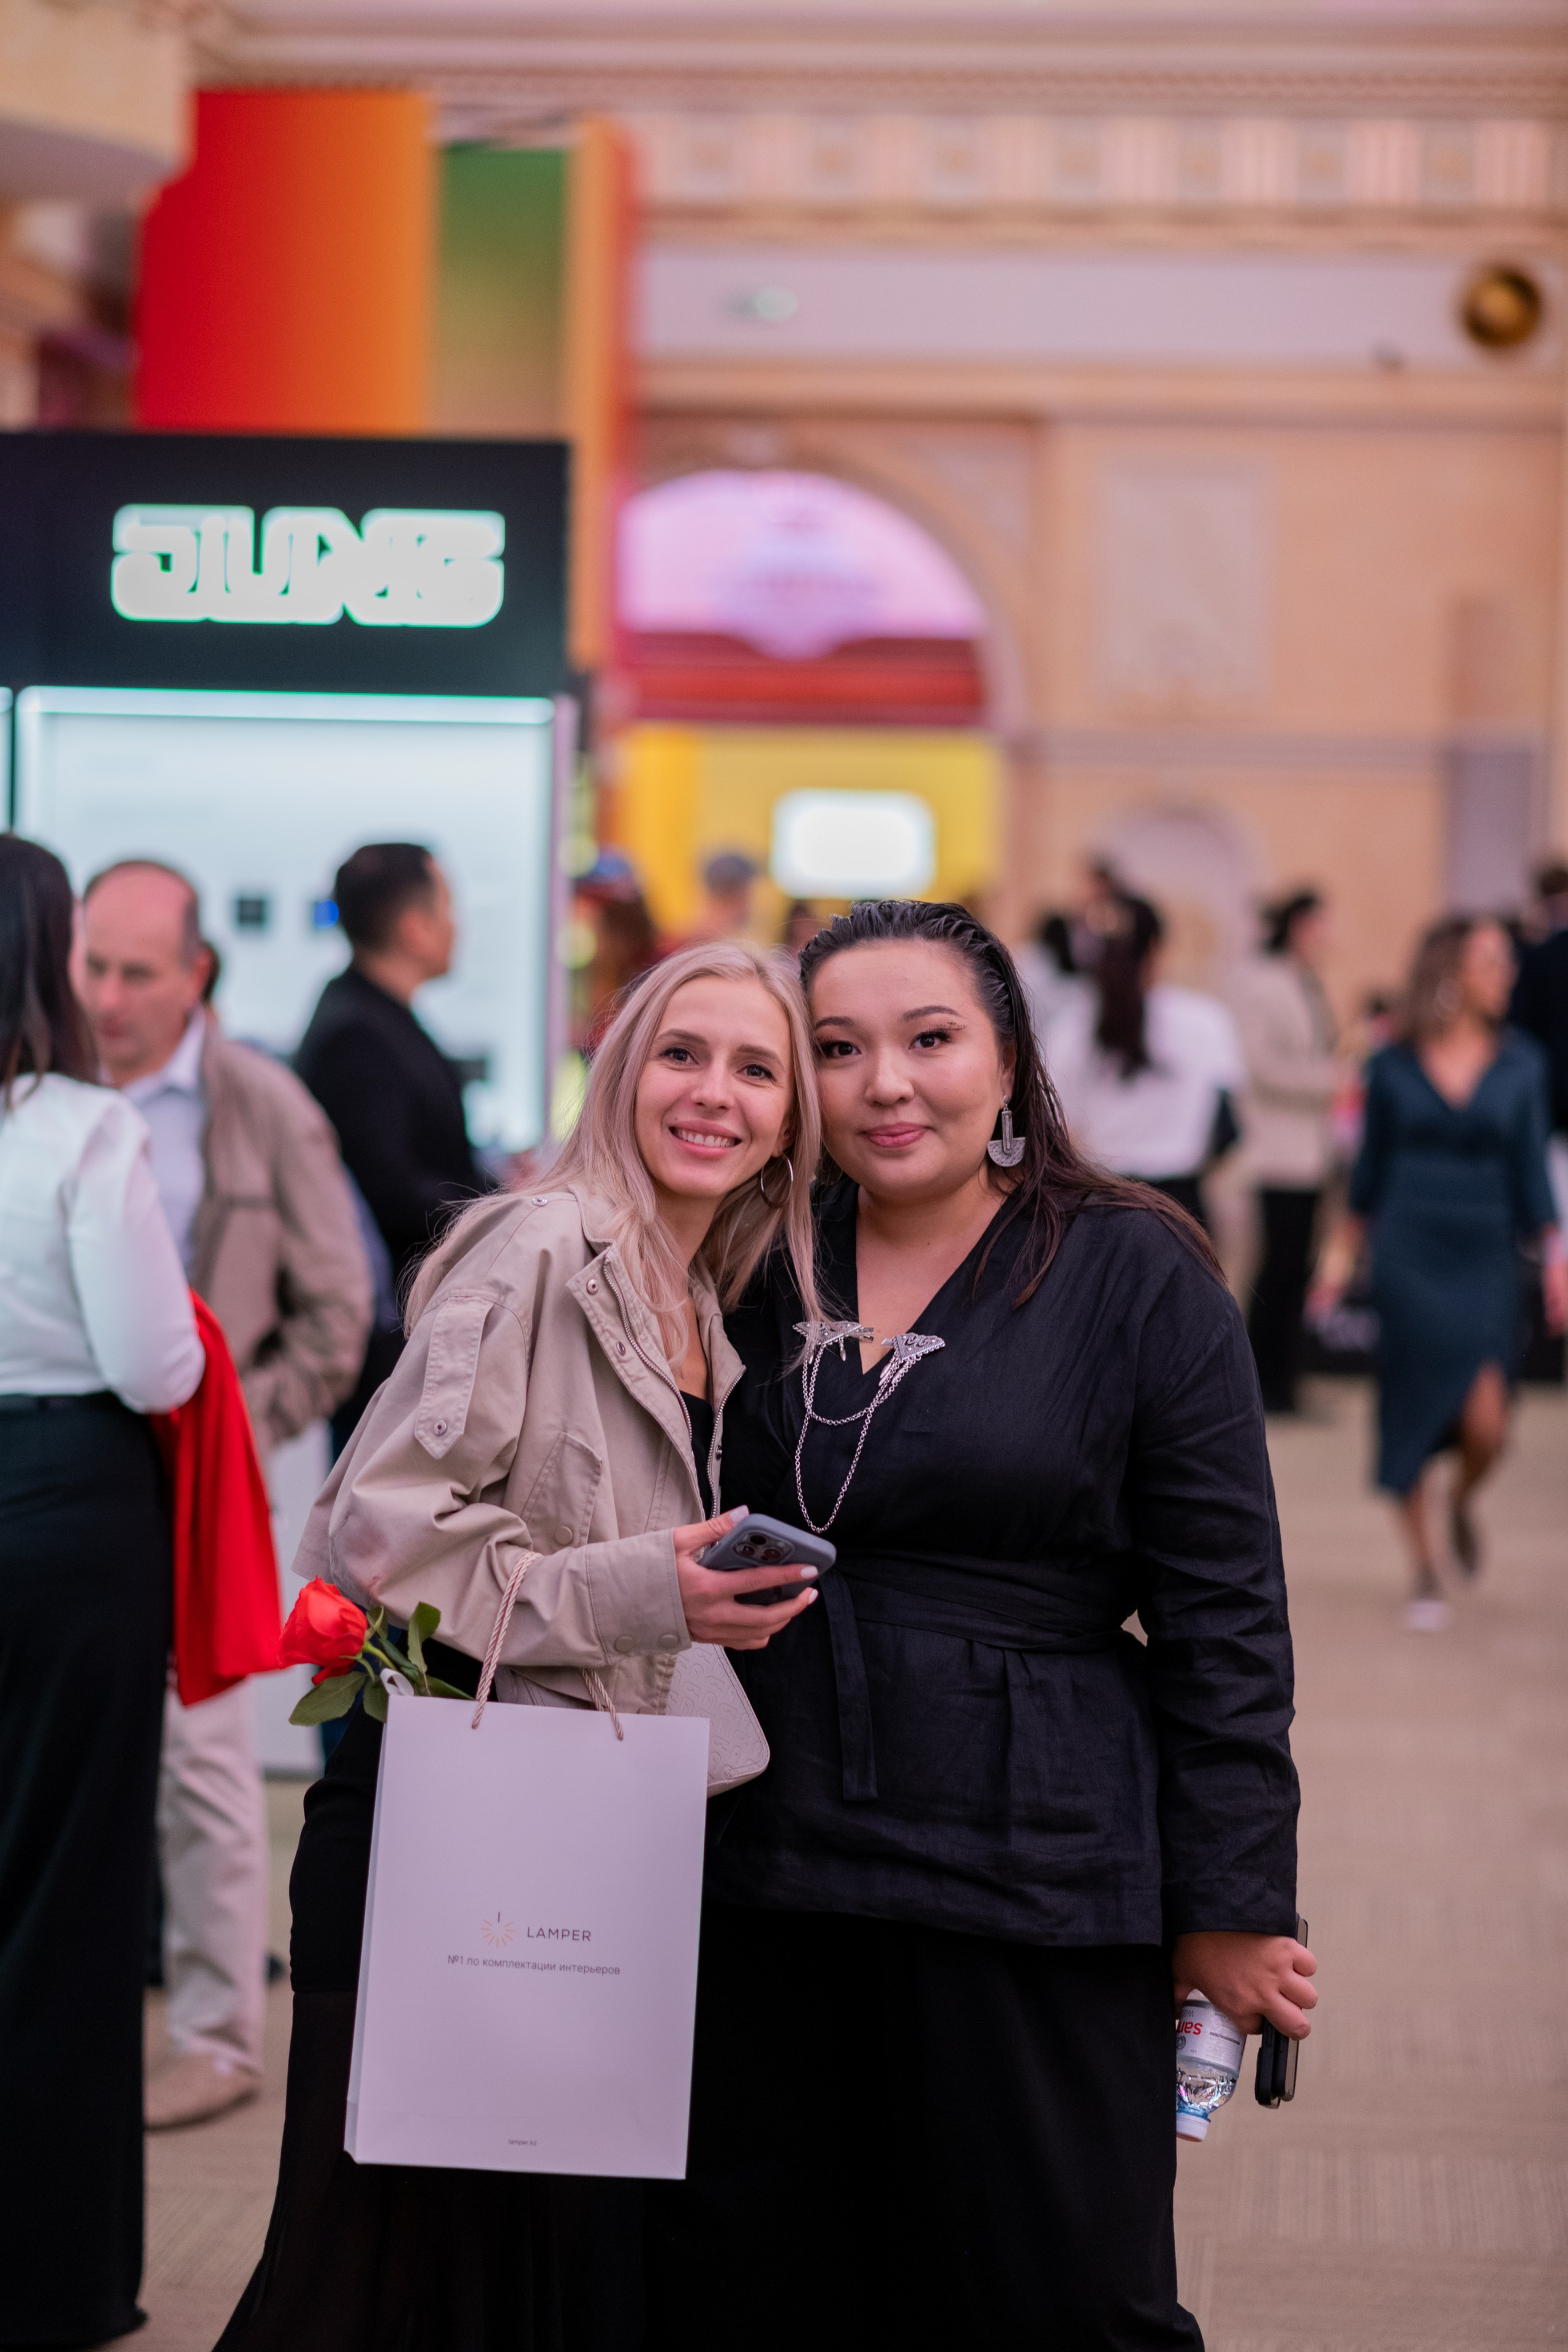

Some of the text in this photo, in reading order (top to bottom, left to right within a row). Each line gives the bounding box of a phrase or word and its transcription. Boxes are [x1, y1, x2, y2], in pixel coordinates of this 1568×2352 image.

[527, 1926, 592, 1942] LAMPER
[448, 1954, 620, 1976] №1 по комплектации интерьеров
